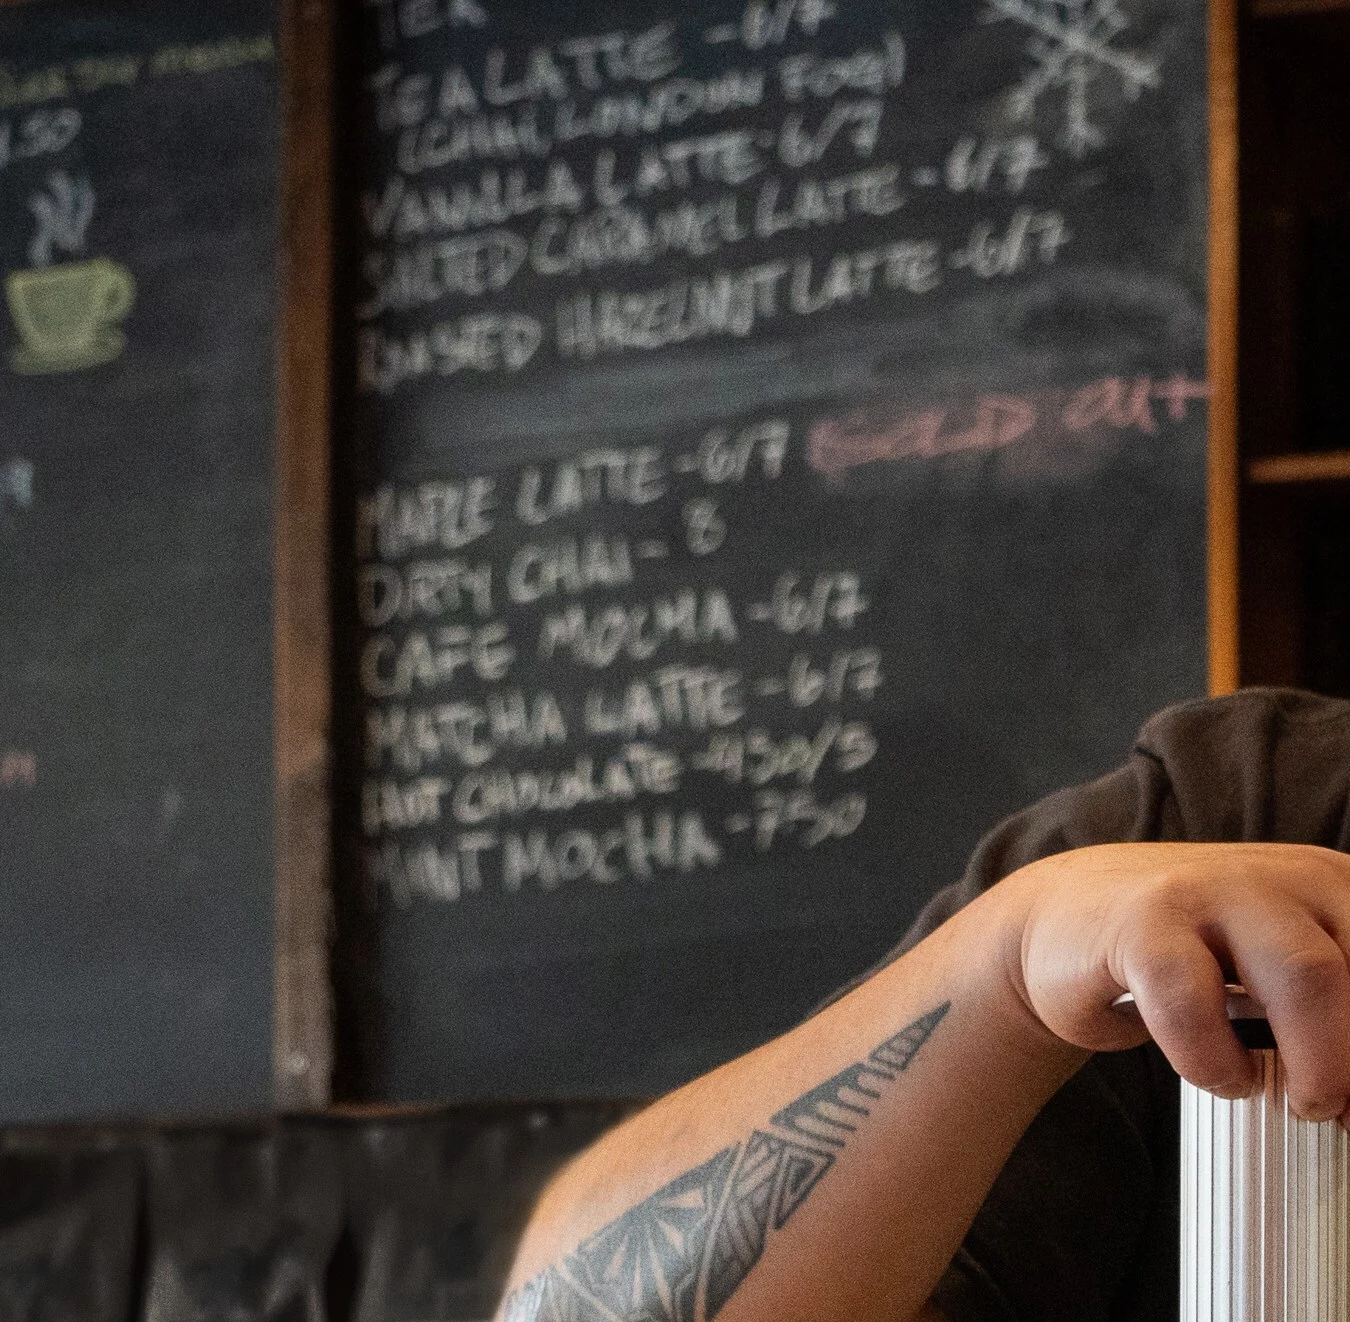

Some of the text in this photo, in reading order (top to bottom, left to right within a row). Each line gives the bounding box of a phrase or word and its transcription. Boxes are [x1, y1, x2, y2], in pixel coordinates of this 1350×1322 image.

[484, 20, 678, 106] LATTE
[555, 70, 765, 140] LONDON
[360, 163, 583, 240] VANILLA
[596, 130, 764, 208] LATTE
[752, 163, 905, 240] LATTE
[789, 240, 941, 315] LATTE
[514, 446, 667, 525] LATTE
[358, 558, 495, 627] DIRTY
[358, 622, 517, 698] CAFE
[537, 587, 739, 668] MOCHA
[363, 688, 567, 769] MATCHA
[586, 664, 745, 735] LATTE
[503, 809, 724, 888] MOCHA
